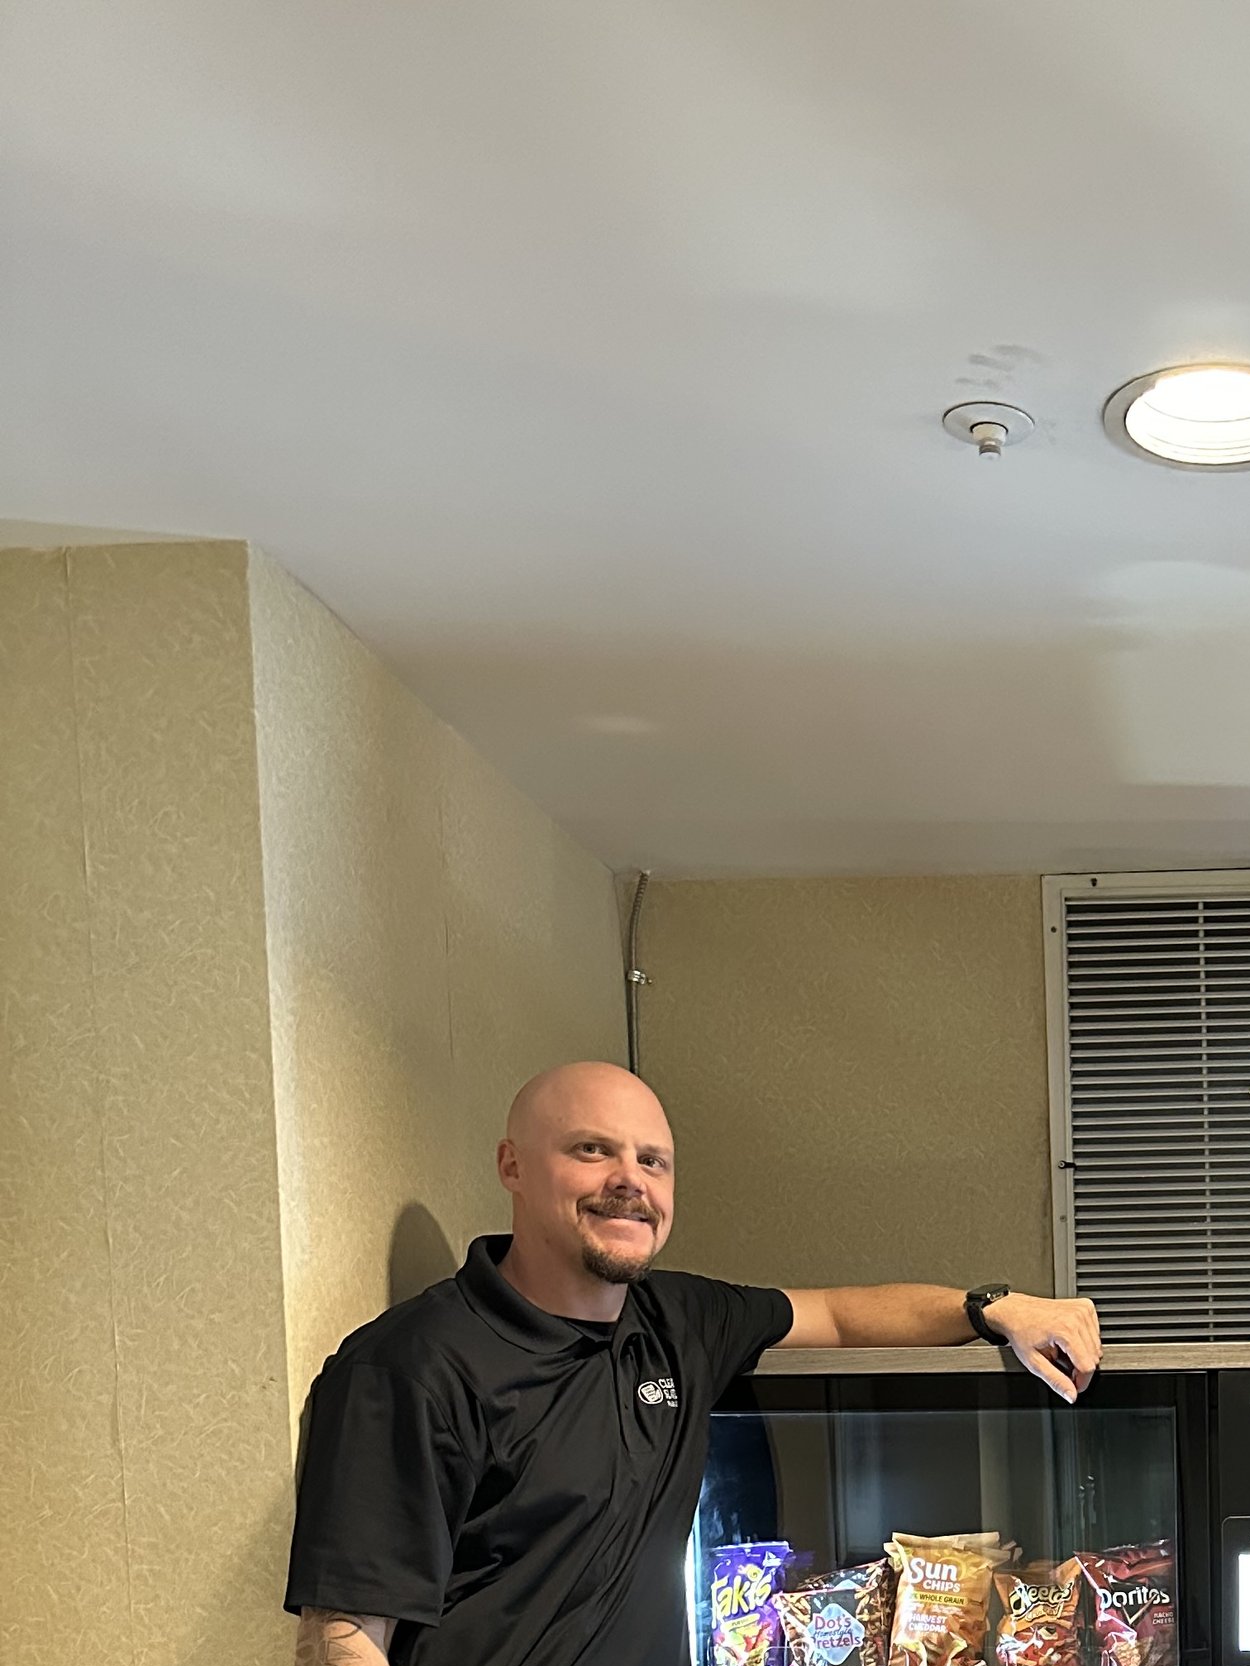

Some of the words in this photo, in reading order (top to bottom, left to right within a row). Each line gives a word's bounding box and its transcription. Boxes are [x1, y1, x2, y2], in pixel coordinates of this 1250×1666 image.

[909, 1558, 957, 1584] Sun
[923, 1580, 961, 1593] CHIPS
[711, 1571, 773, 1629] Takis
[919, 1594, 942, 1602] WHOLE
[943, 1597, 965, 1605] GRAIN
[1100, 1585, 1171, 1609] Doritos
[814, 1615, 851, 1630] Dot's
[910, 1613, 948, 1624] HARVEST
[908, 1623, 948, 1633] CHEDDAR
